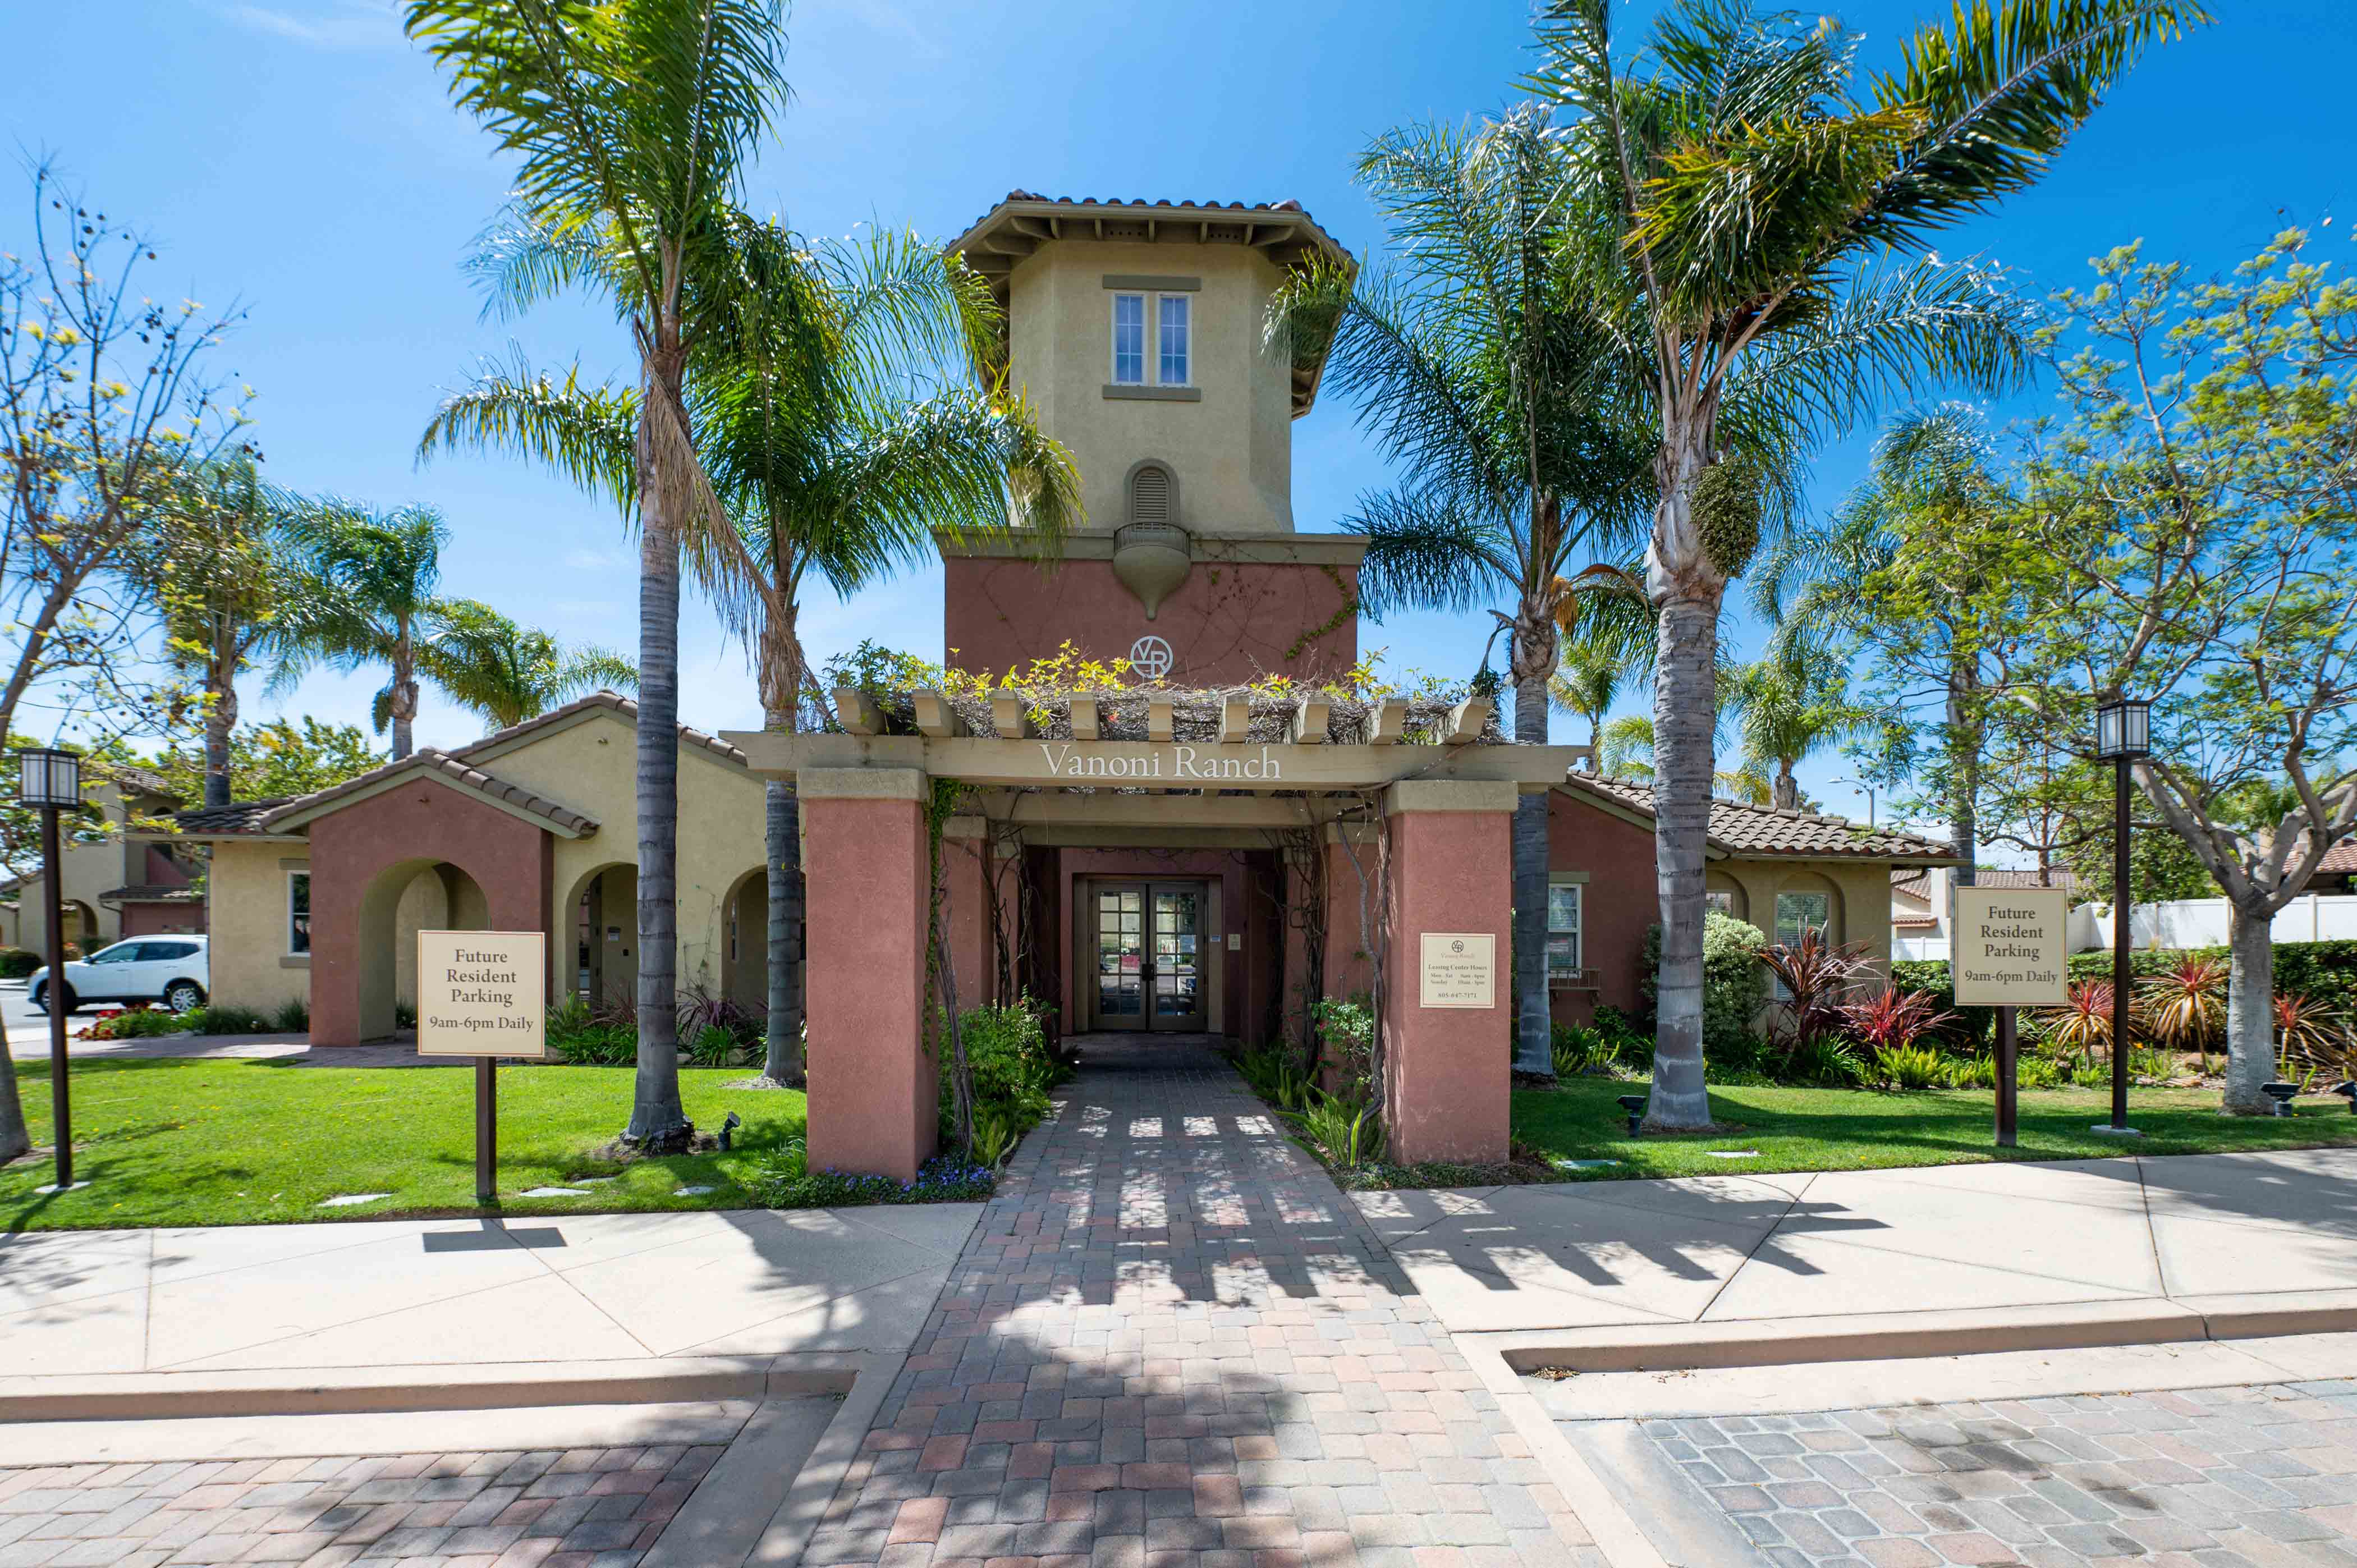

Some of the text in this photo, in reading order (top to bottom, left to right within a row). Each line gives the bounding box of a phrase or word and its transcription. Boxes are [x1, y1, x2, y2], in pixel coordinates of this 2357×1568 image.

[1039, 744, 1281, 779] Vanoni Ranch
[1988, 906, 2036, 919] Future
[1980, 924, 2043, 938] Resident
[455, 949, 508, 963] Future
[1984, 943, 2040, 962] Parking
[446, 968, 517, 983] Resident
[1965, 970, 2058, 985] 9am-6pm Daily
[451, 988, 513, 1007] Parking
[429, 1016, 534, 1033] 9am-6pm Daily
